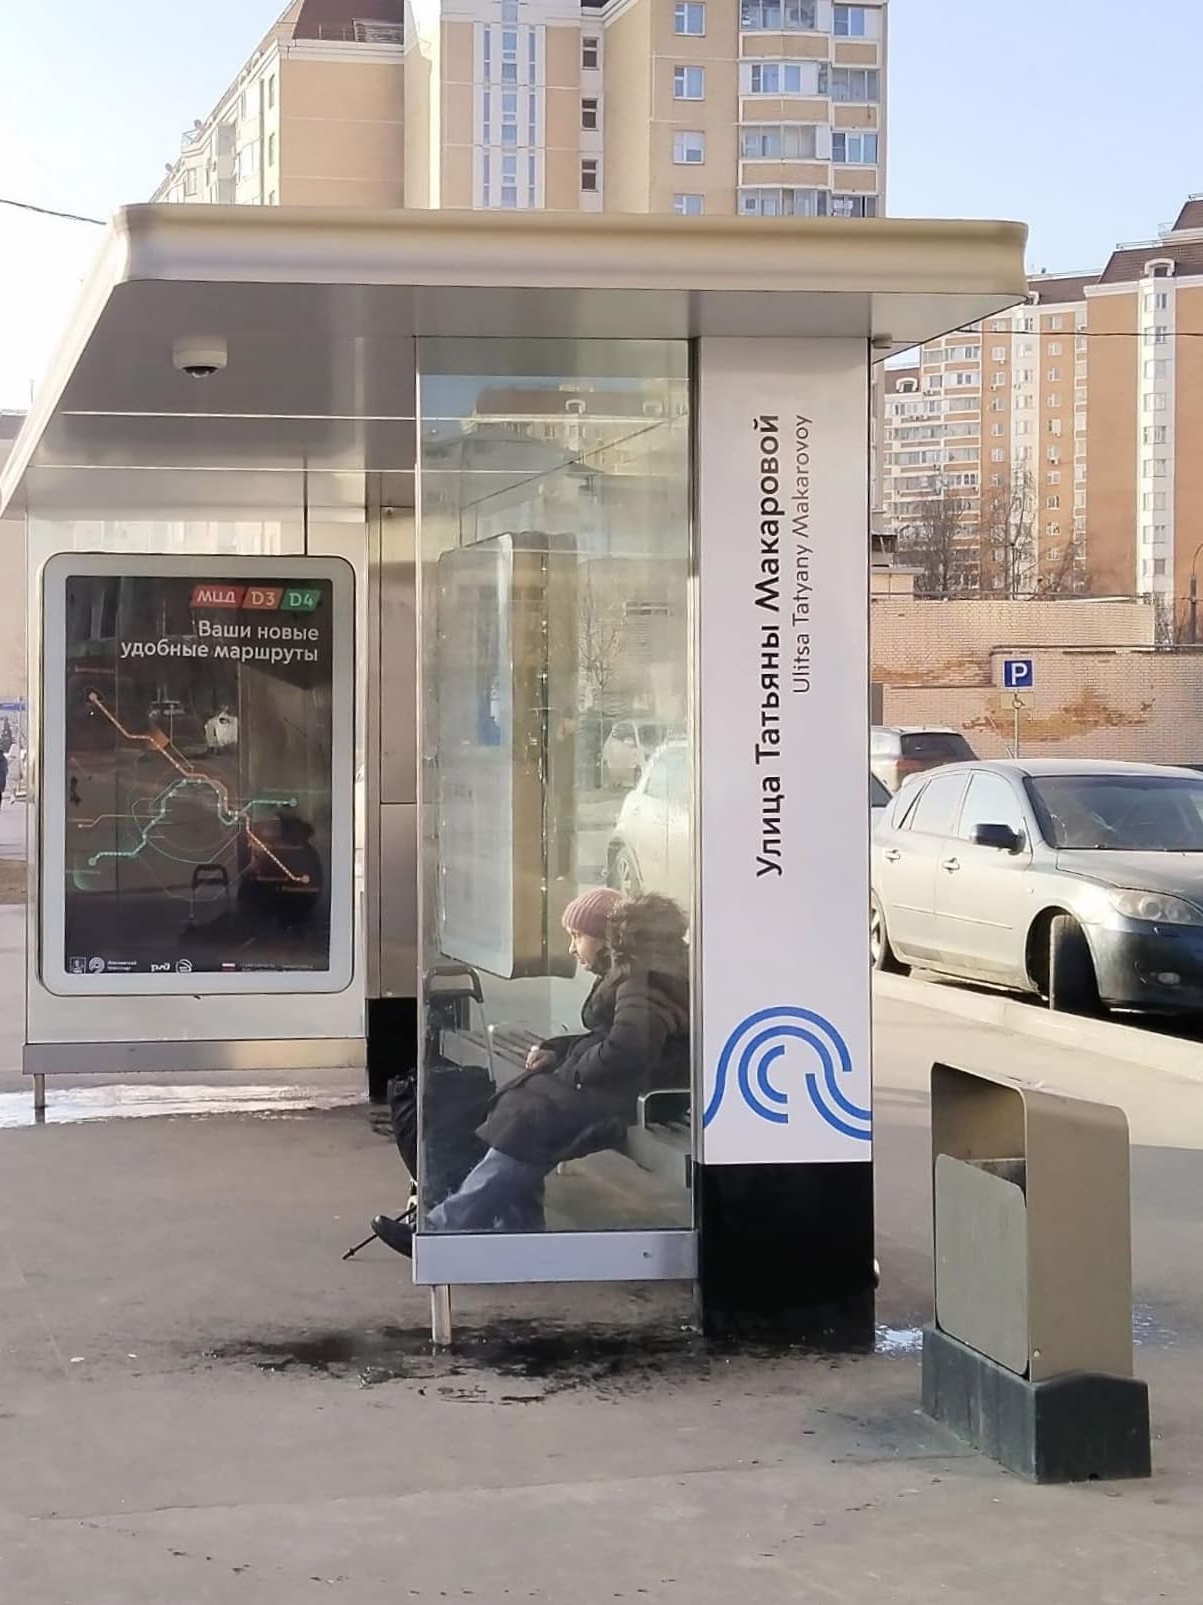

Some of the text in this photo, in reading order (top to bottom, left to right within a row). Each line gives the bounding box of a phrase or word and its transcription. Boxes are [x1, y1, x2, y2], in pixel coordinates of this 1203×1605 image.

[791, 414, 813, 693] Ulitsa Tatyany Makarovoy
[197, 590, 314, 607] МЦД D3 D4
[198, 619, 319, 641] Ваши новые
[120, 638, 318, 664] удобные маршруты
[753, 414, 784, 877] Улица Татьяны Макаровой
[1011, 662, 1028, 685] P
